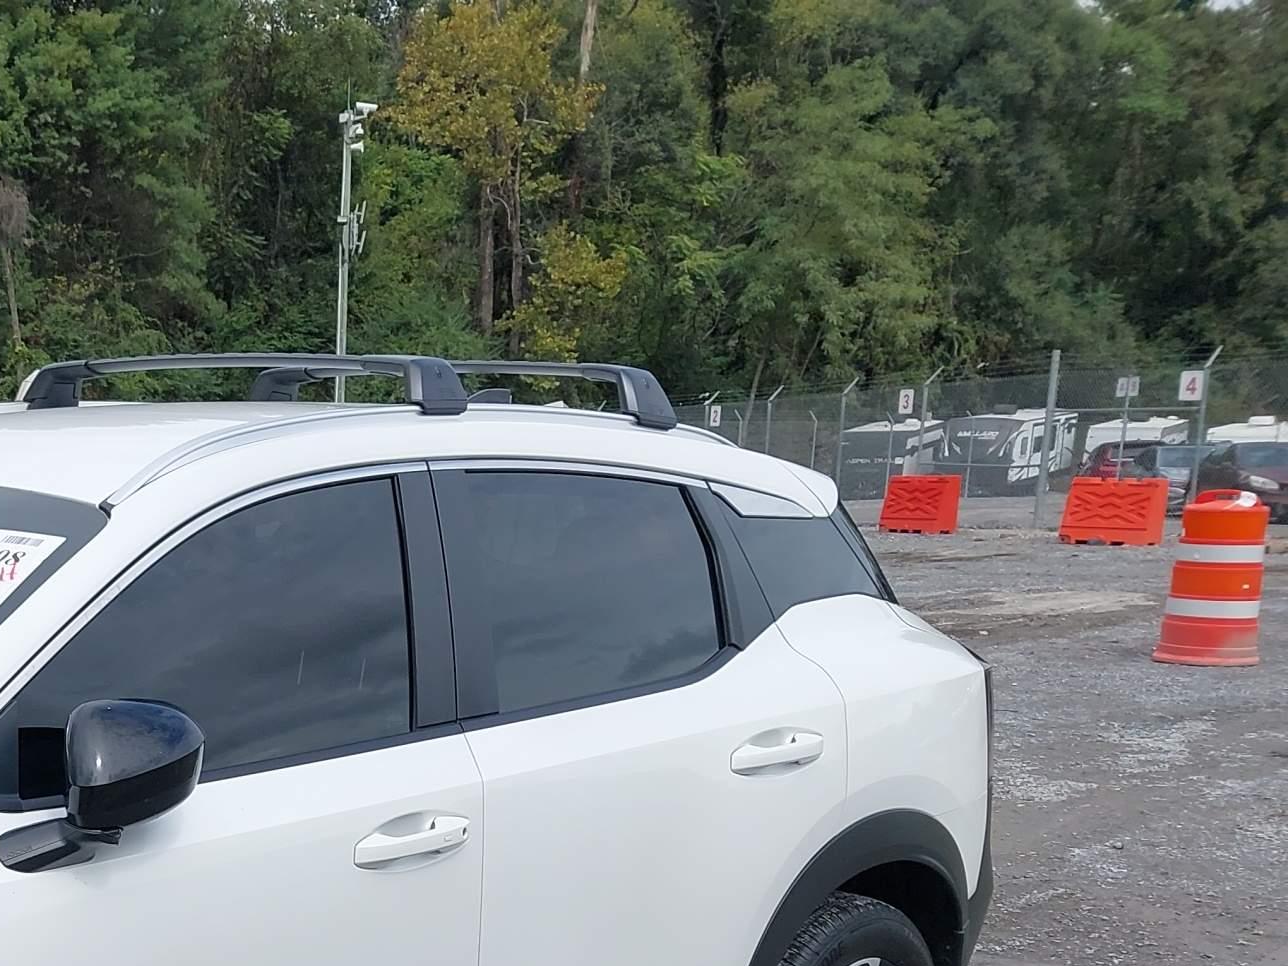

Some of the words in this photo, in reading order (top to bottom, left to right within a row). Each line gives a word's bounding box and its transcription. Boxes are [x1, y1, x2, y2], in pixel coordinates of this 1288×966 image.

[1185, 376, 1198, 396] 4
[902, 393, 910, 410] 3
[712, 409, 719, 423] 2
